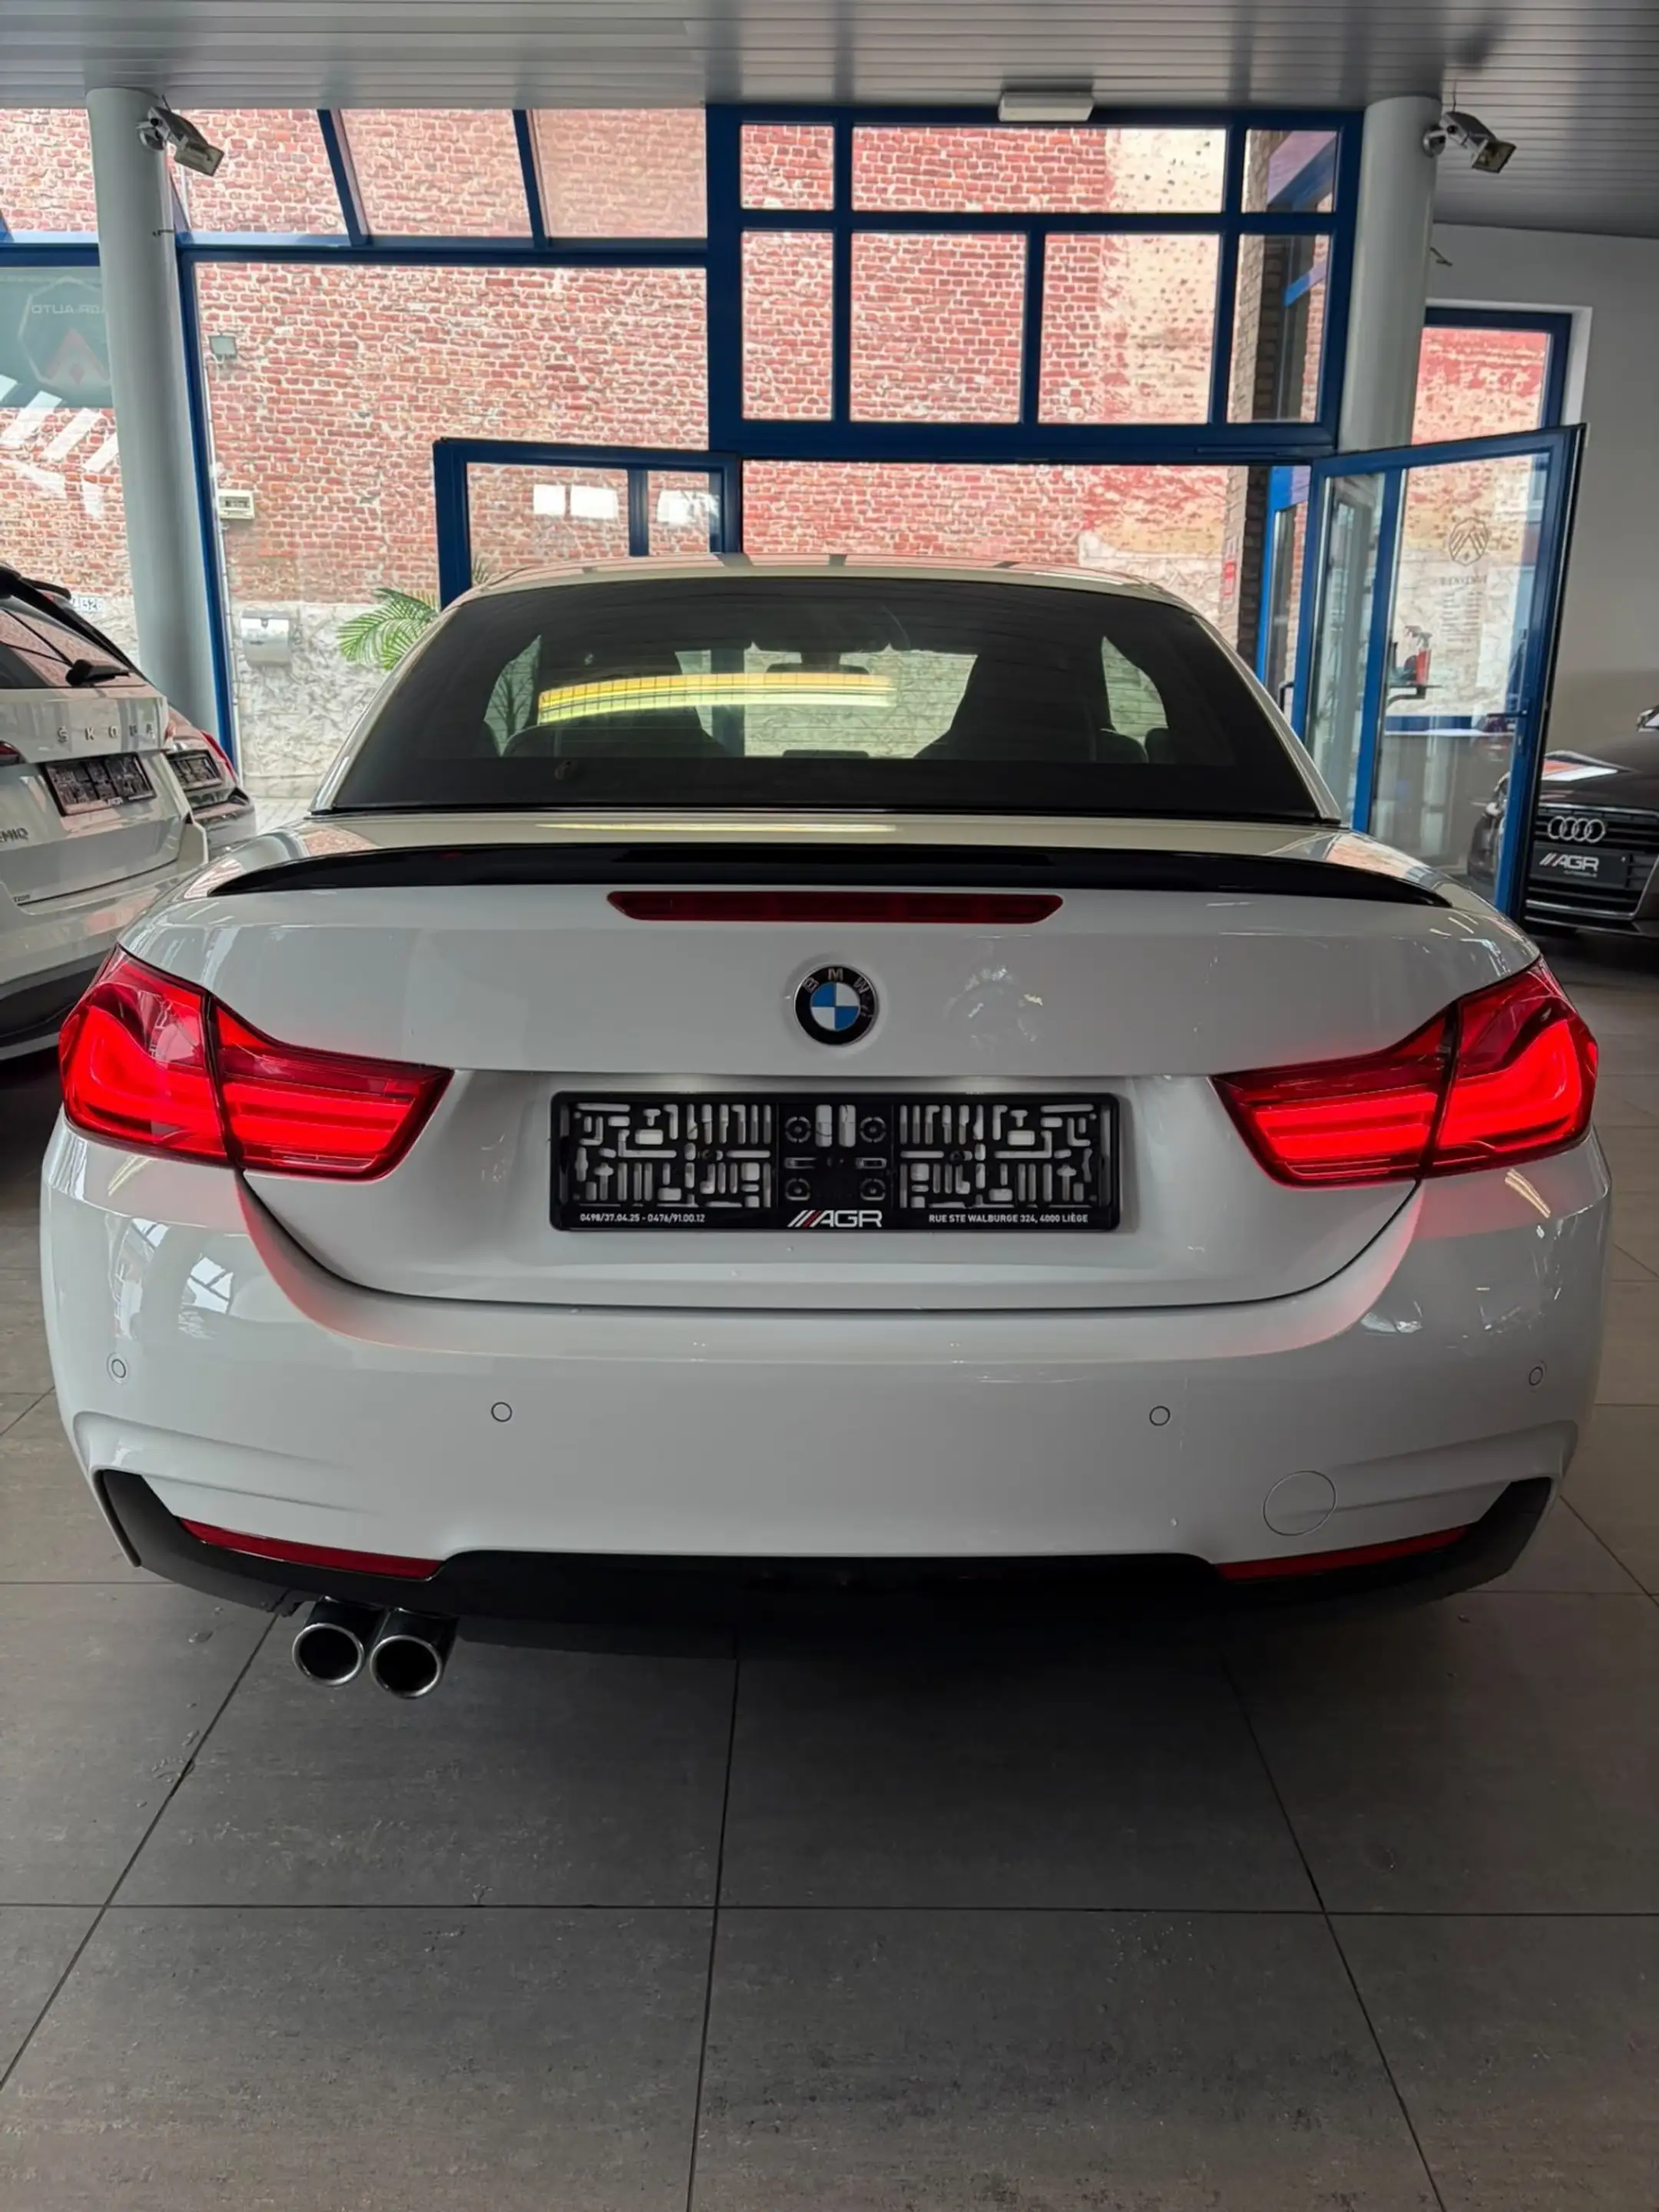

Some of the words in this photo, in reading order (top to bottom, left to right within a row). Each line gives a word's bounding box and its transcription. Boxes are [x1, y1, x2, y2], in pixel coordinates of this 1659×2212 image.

[1551, 853, 1600, 873] AGR
[802, 967, 870, 994] BMW
[809, 1209, 883, 1228] AGR
[929, 1214, 947, 1223] RUE
[949, 1214, 965, 1223] STE
[967, 1214, 1018, 1223] WALBURGE
[1040, 1214, 1060, 1223] 4000
